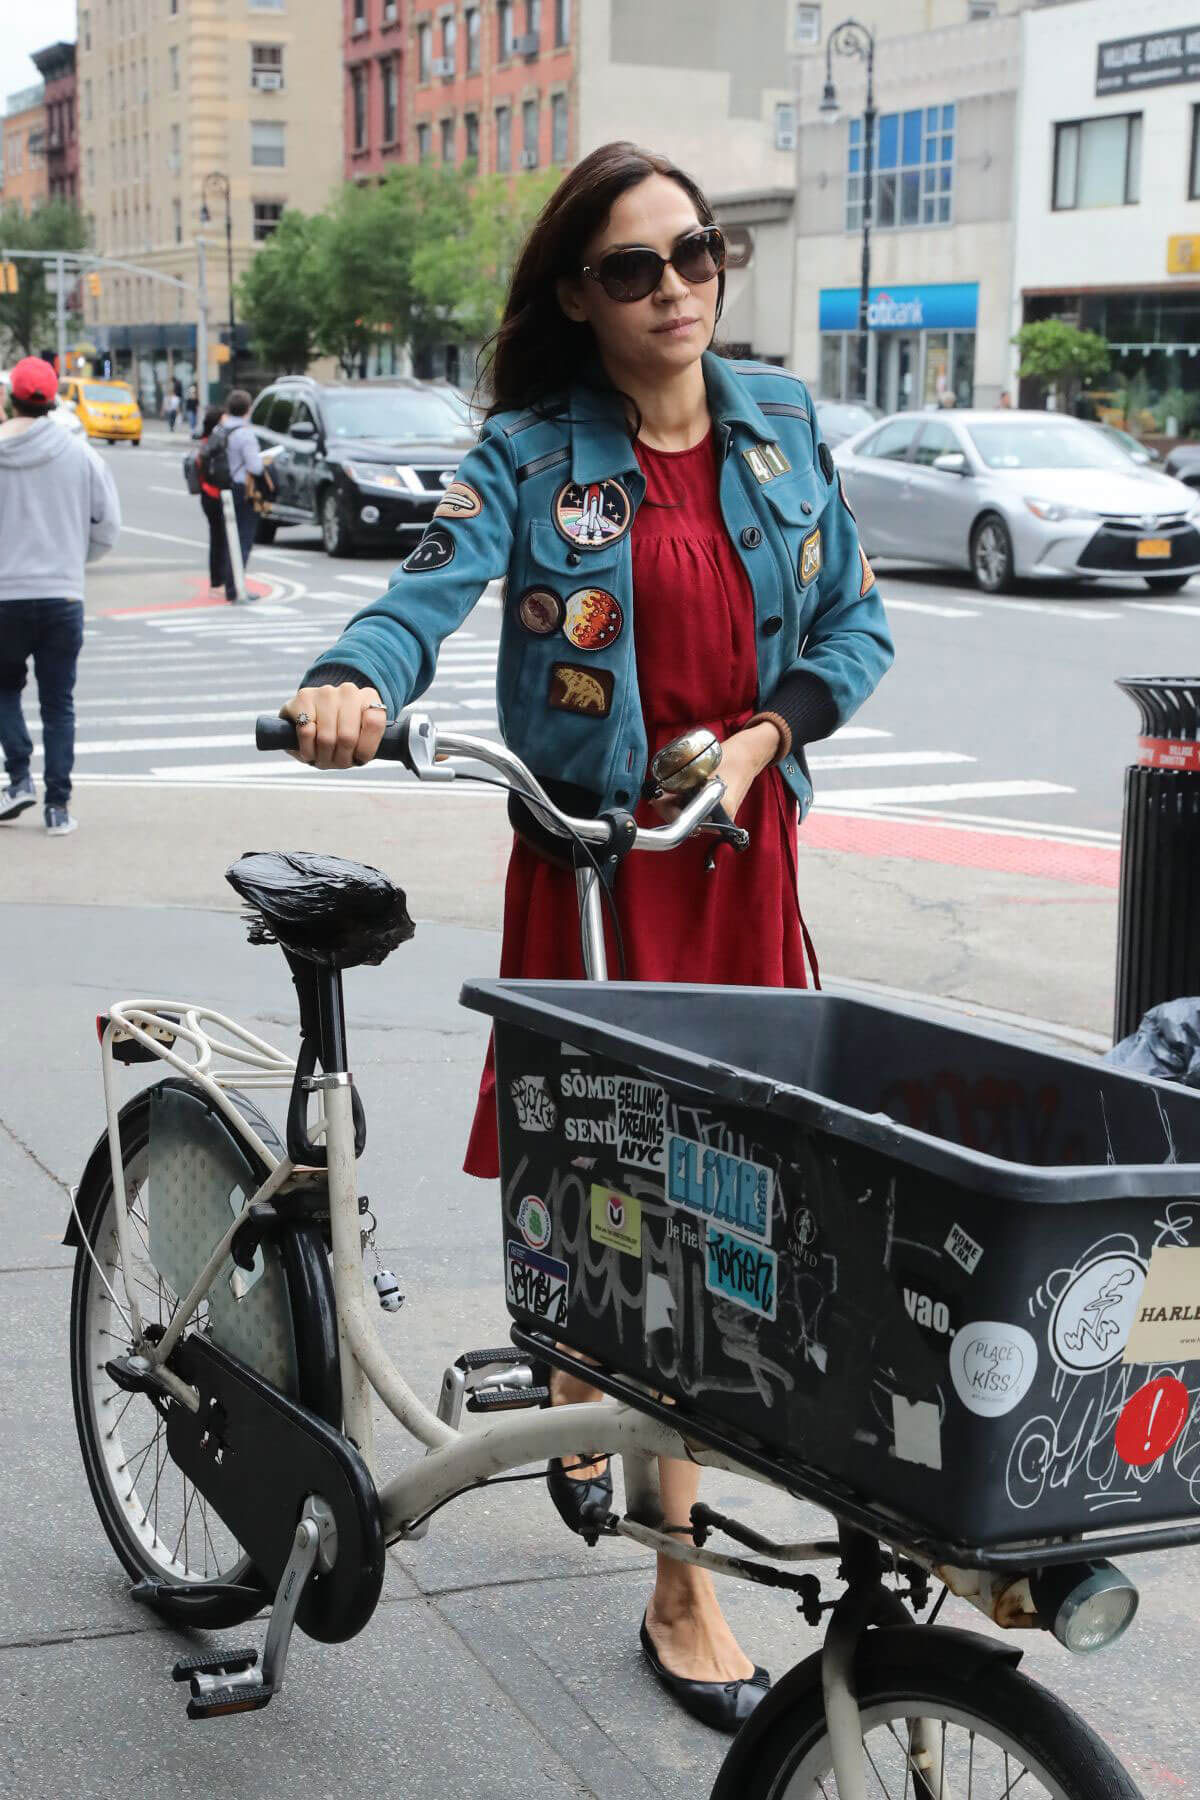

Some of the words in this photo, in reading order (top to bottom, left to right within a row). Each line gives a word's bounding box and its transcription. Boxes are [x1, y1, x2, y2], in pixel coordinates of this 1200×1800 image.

[617, 1081, 664, 1117] SELLING
[619, 1110, 664, 1146] DREAMS
[619, 1139, 665, 1166] NYC
[666, 1217, 680, 1240] De
[951, 1227, 978, 1260] ROME
[951, 1242, 970, 1266] ERA
[975, 1342, 1014, 1361] PLACE
[987, 1359, 1000, 1374] 2
[972, 1370, 1011, 1392] KISS
